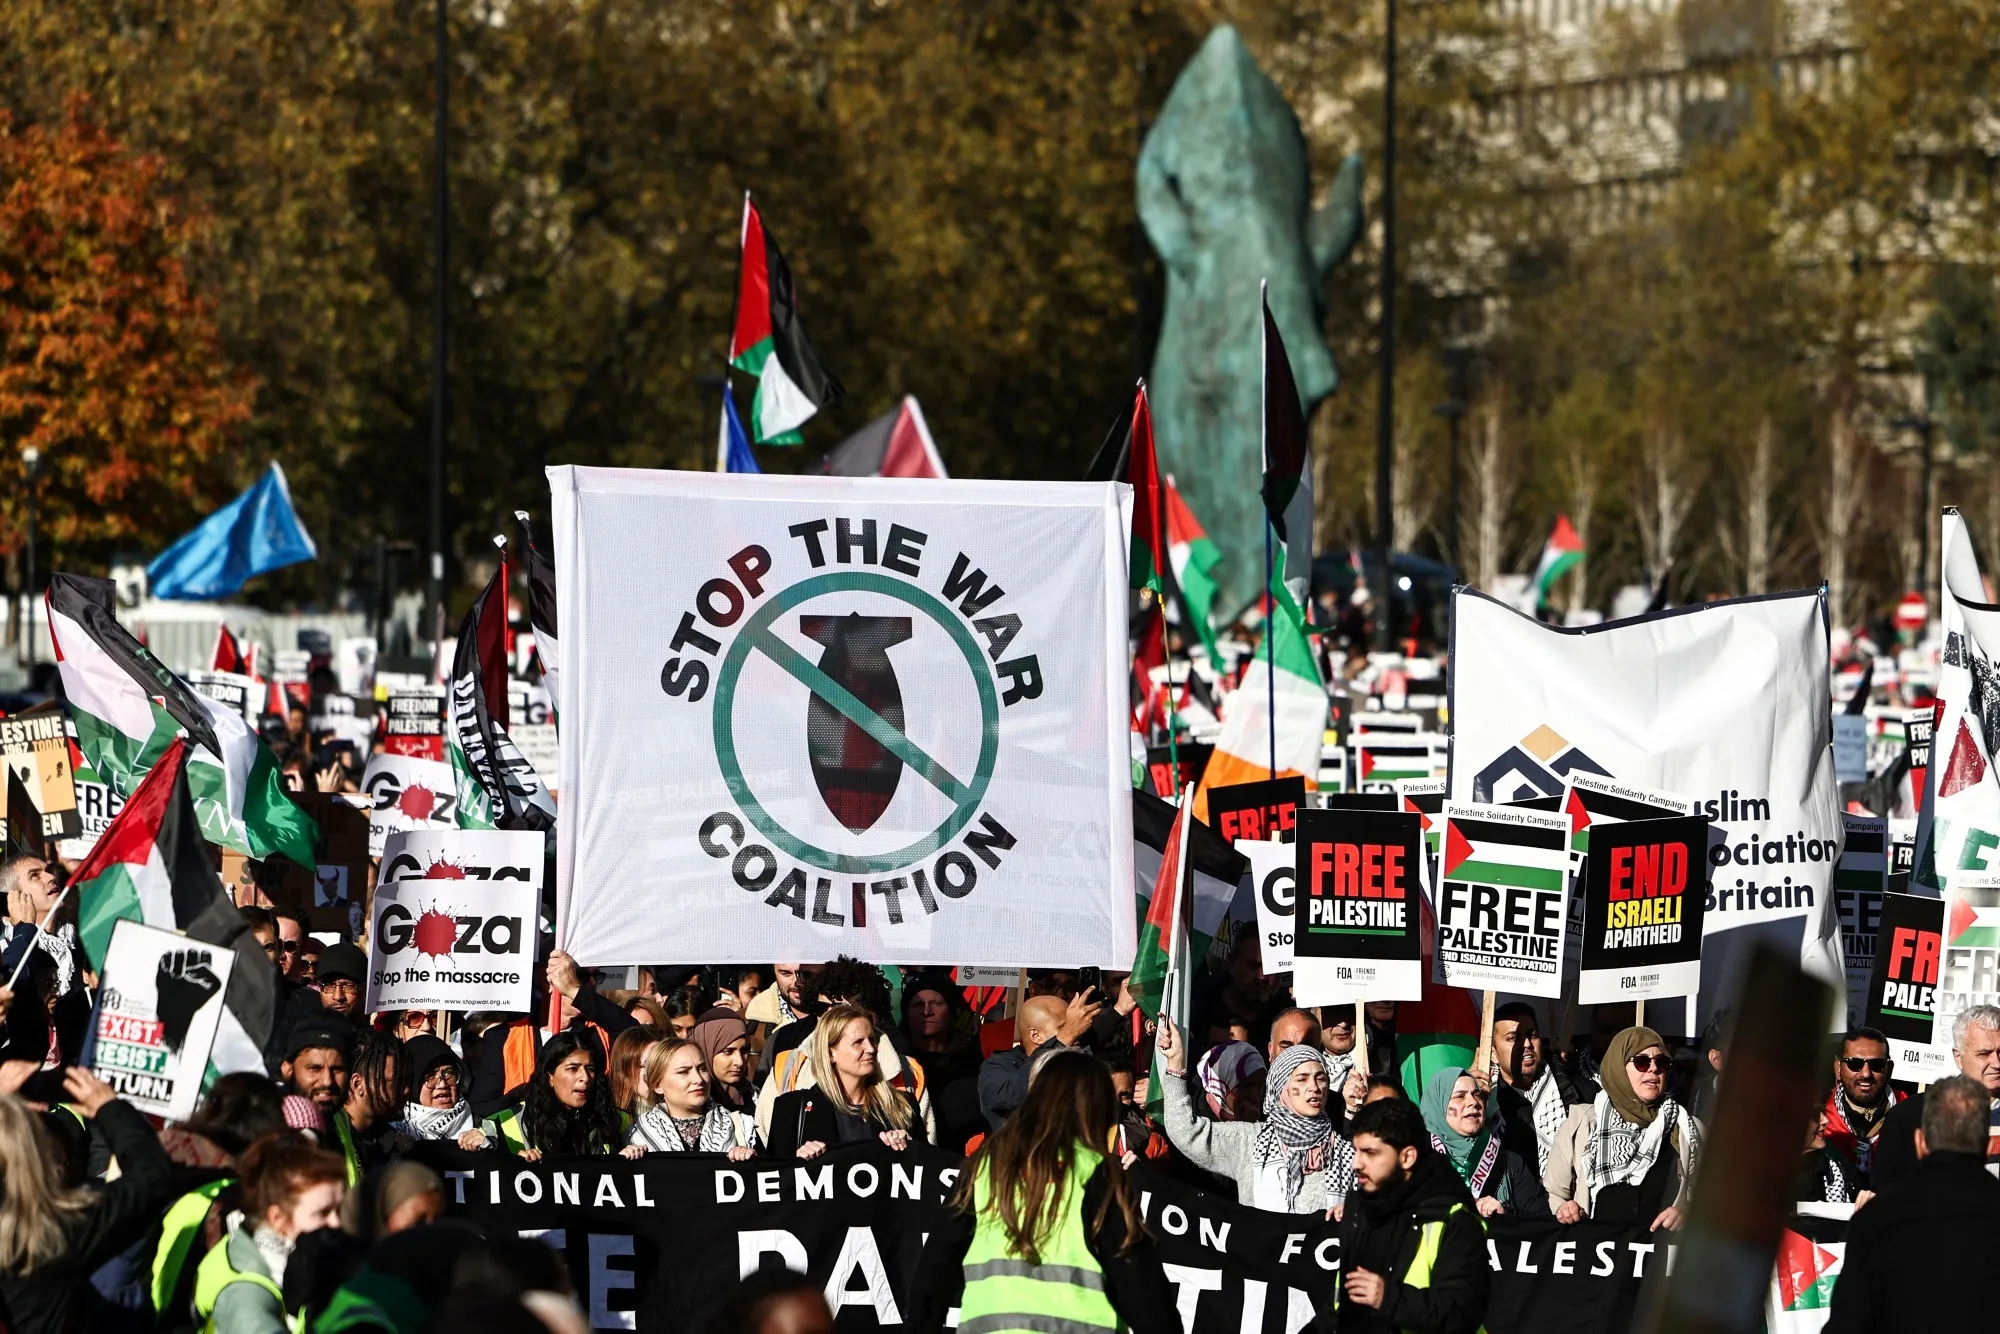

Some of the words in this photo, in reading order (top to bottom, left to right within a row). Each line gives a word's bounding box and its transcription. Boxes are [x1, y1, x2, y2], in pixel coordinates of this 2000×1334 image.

[660, 543, 772, 703] STOP
[788, 517, 928, 578] THE
[941, 551, 1044, 708] WAR
[391, 698, 439, 714] FREEDOM
[0, 716, 63, 744] ESTINE
[388, 718, 441, 734] PALESTINE
[32, 737, 65, 752] TODAY
[1403, 784, 1439, 793] Palestine
[1573, 775, 1609, 792] Palestine
[1609, 784, 1647, 802] Solidarity
[1648, 794, 1688, 811] Campaign
[1448, 807, 1485, 819] Palestine
[1486, 811, 1525, 823] Solidarity
[1527, 815, 1567, 829] Campaign
[1694, 790, 1770, 822] slim
[1845, 822, 1884, 832] Campaign
[1709, 831, 1837, 867] ociation
[698, 811, 1018, 928] COALITION
[1311, 842, 1405, 899] FREE
[1608, 842, 1689, 902] END
[1309, 899, 1407, 928] PALESTINE
[1440, 881, 1562, 937] FREE
[1606, 896, 1683, 930] ISRAELI
[1268, 931, 1294, 947] Sto
[1438, 926, 1558, 960] PALESTINE
[1603, 923, 1683, 950] APARTHEID
[1442, 950, 1459, 962] END
[1460, 952, 1497, 967] ISRAELI
[1498, 957, 1556, 973] OCCUPATION
[1888, 926, 1942, 985] FR
[373, 969, 401, 987] Stop
[405, 967, 430, 983] the
[435, 971, 520, 984] massacre
[978, 968, 1020, 977] www.palestinec
[1337, 967, 1353, 980] FOA
[1455, 968, 1538, 985] www.palestinecampaign.org
[1620, 976, 1637, 989] FOA
[1640, 973, 1660, 982] FRIENDS
[98, 1014, 162, 1045] EXIST.
[1903, 1049, 1920, 1063] FOA
[94, 1068, 172, 1101] ETURN.
[1471, 1139, 1499, 1192] ESTINE
[444, 1169, 655, 1208] TIONAL
[1279, 1233, 1341, 1271] FO
